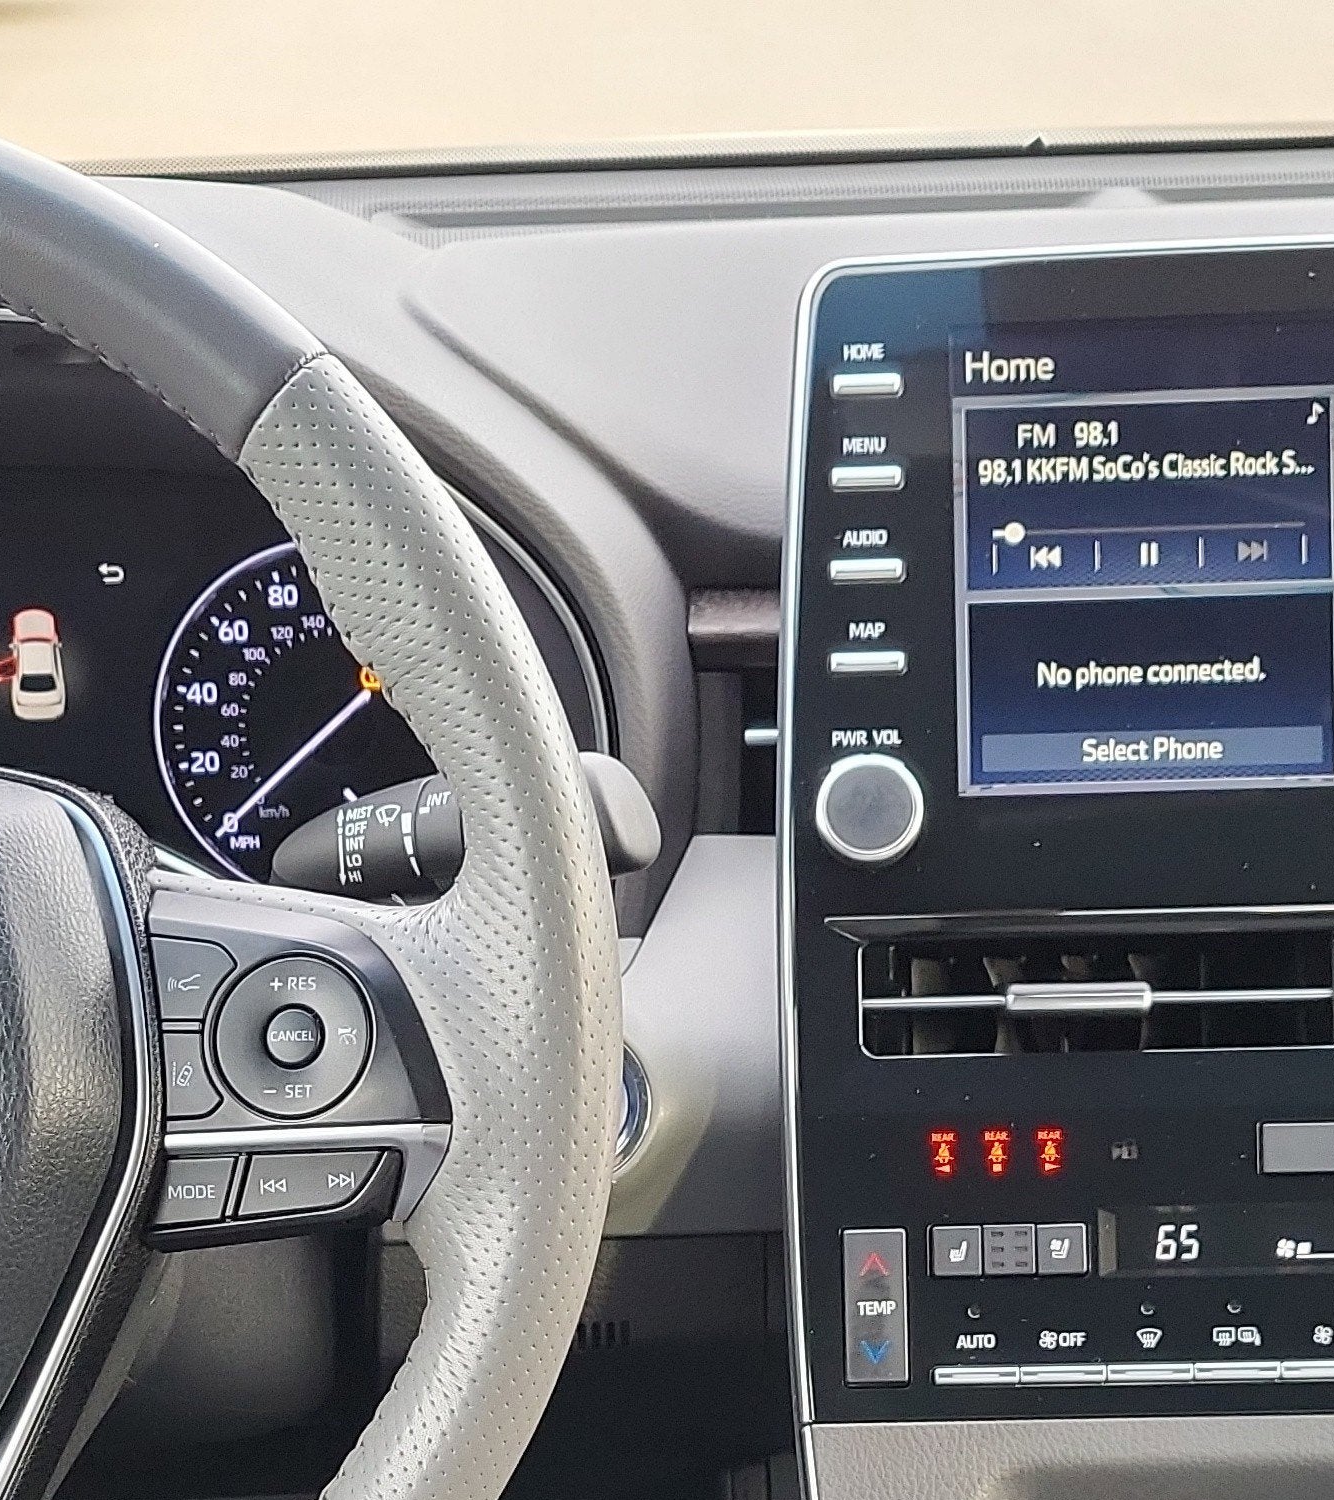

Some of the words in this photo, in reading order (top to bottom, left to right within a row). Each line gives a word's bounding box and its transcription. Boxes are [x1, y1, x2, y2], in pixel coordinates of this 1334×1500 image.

[842, 343, 885, 361] HOME
[966, 351, 1055, 382] Home
[1017, 422, 1056, 448] FM
[1074, 421, 1119, 447] 98.1
[842, 437, 886, 454] MENU
[978, 458, 1021, 487] 98.1
[1026, 456, 1089, 483] KKFM
[1092, 452, 1160, 480] SoCo's
[1162, 452, 1227, 479] Classic
[1229, 450, 1280, 476] Rock
[1281, 450, 1315, 475] S...
[842, 529, 888, 547] AUDIO
[268, 584, 298, 608] 80
[301, 614, 325, 629] 140
[218, 619, 249, 643] 60
[271, 626, 293, 640] 120
[848, 622, 886, 639] MAP
[243, 648, 265, 661] 100
[228, 672, 247, 686] 80
[1037, 660, 1071, 686] No
[1075, 661, 1143, 690] phone
[1147, 655, 1267, 685] connected.
[186, 682, 217, 704] 40
[221, 703, 239, 717] 60
[221, 735, 239, 748] 40
[831, 729, 868, 746] PWR
[873, 728, 902, 745] VOL
[1082, 737, 1149, 762] Select
[1153, 736, 1224, 761] Phone
[190, 751, 220, 772] 20
[231, 766, 248, 779] 20
[427, 792, 451, 806] INT
[346, 807, 373, 820] MIST
[345, 822, 367, 834] OFF
[230, 834, 260, 850] MPH
[345, 837, 365, 851] INT
[346, 854, 362, 867] LO
[348, 871, 362, 882] HI
[270, 1029, 314, 1042] CANCEL
[168, 1184, 216, 1199] MODE
[1156, 1224, 1200, 1261] 65
[857, 1300, 896, 1317] TEMP
[956, 1333, 996, 1350] AUTO
[1059, 1332, 1086, 1348] OFF
